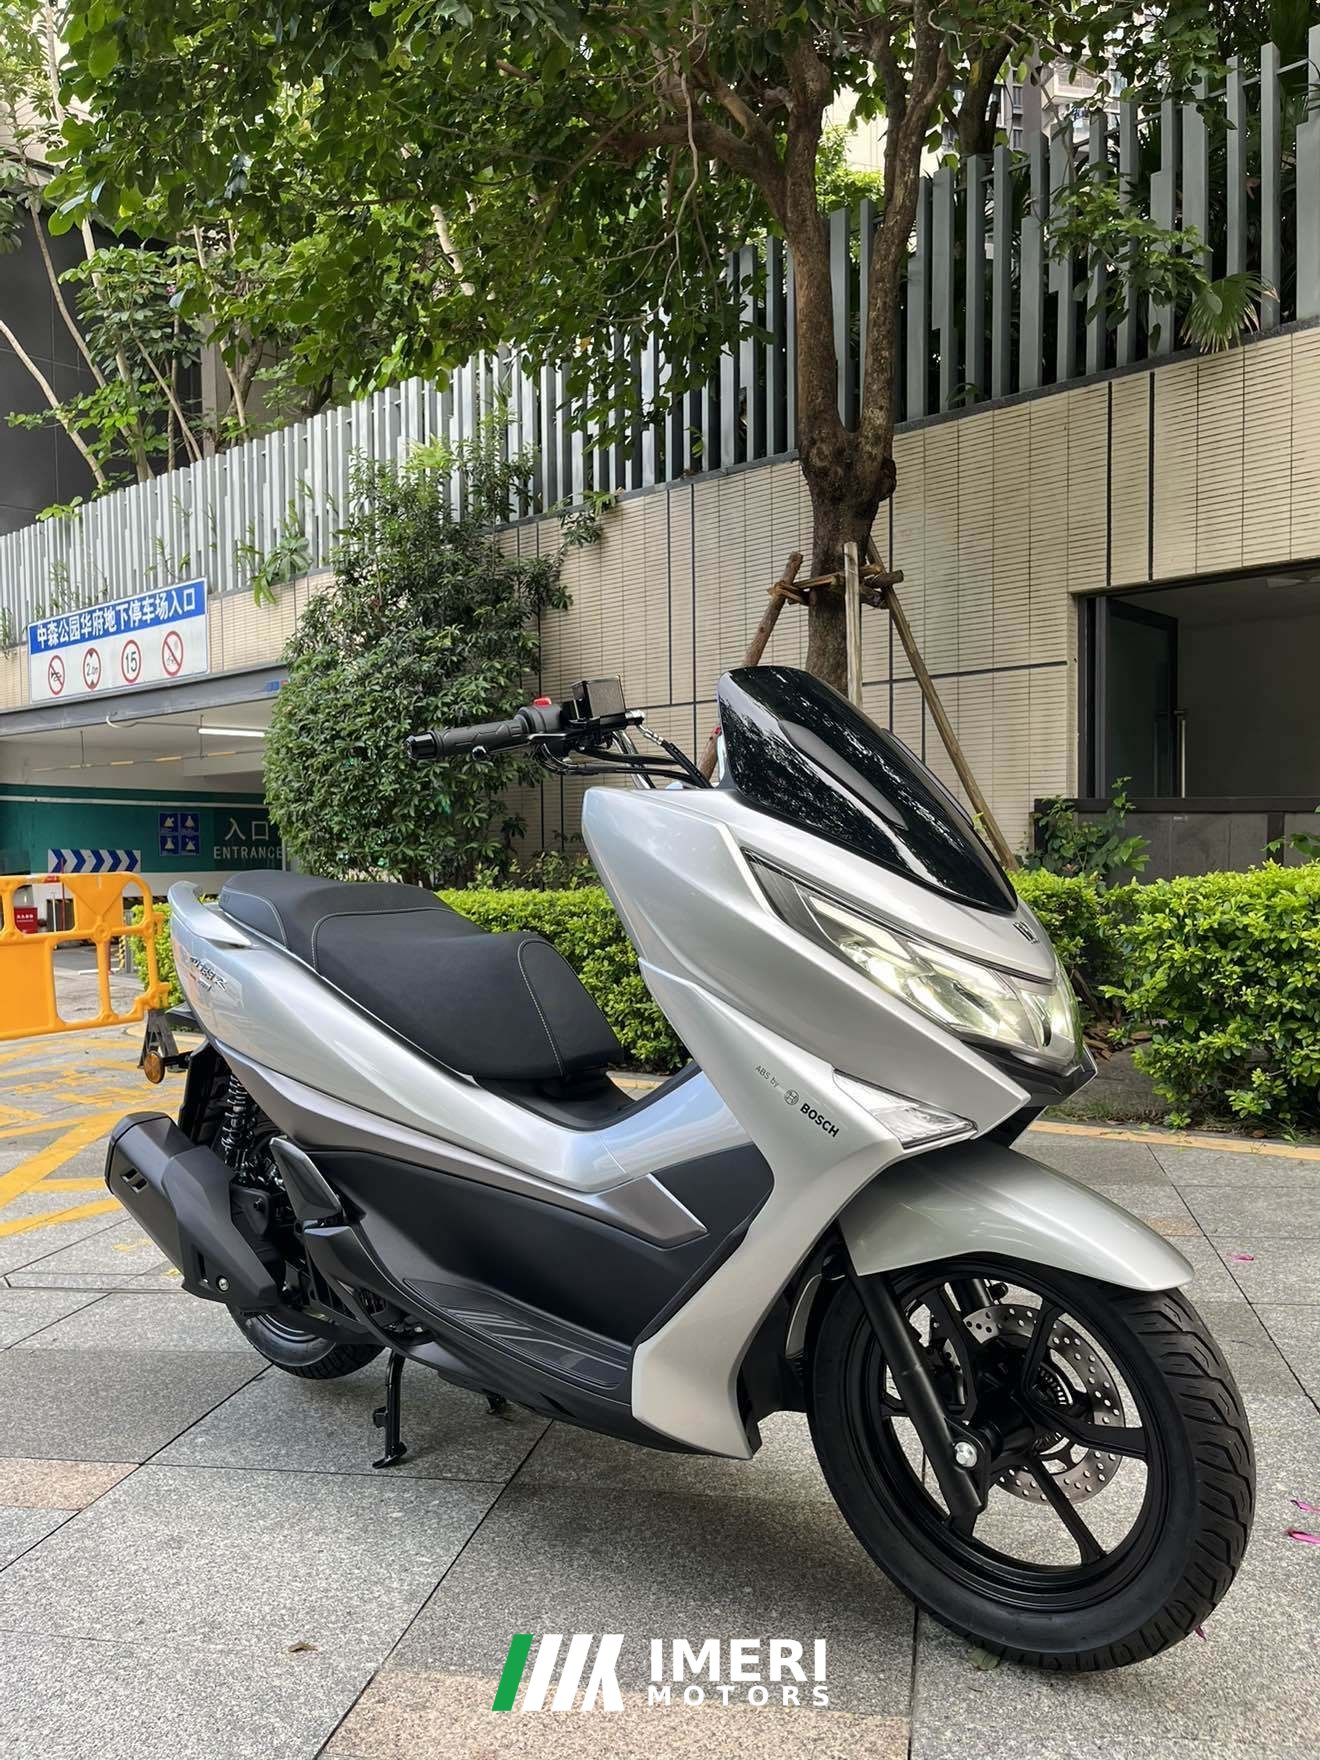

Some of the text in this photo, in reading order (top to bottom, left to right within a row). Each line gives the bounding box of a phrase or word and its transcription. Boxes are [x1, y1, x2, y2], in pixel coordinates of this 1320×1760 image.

[37, 587, 196, 649] 中森公园华府地下停车场入口
[125, 651, 138, 674] 15
[225, 817, 269, 841] 入口
[213, 846, 282, 859] ENTRANCE
[755, 1065, 771, 1080] ABS
[800, 1102, 840, 1138] BOSCH
